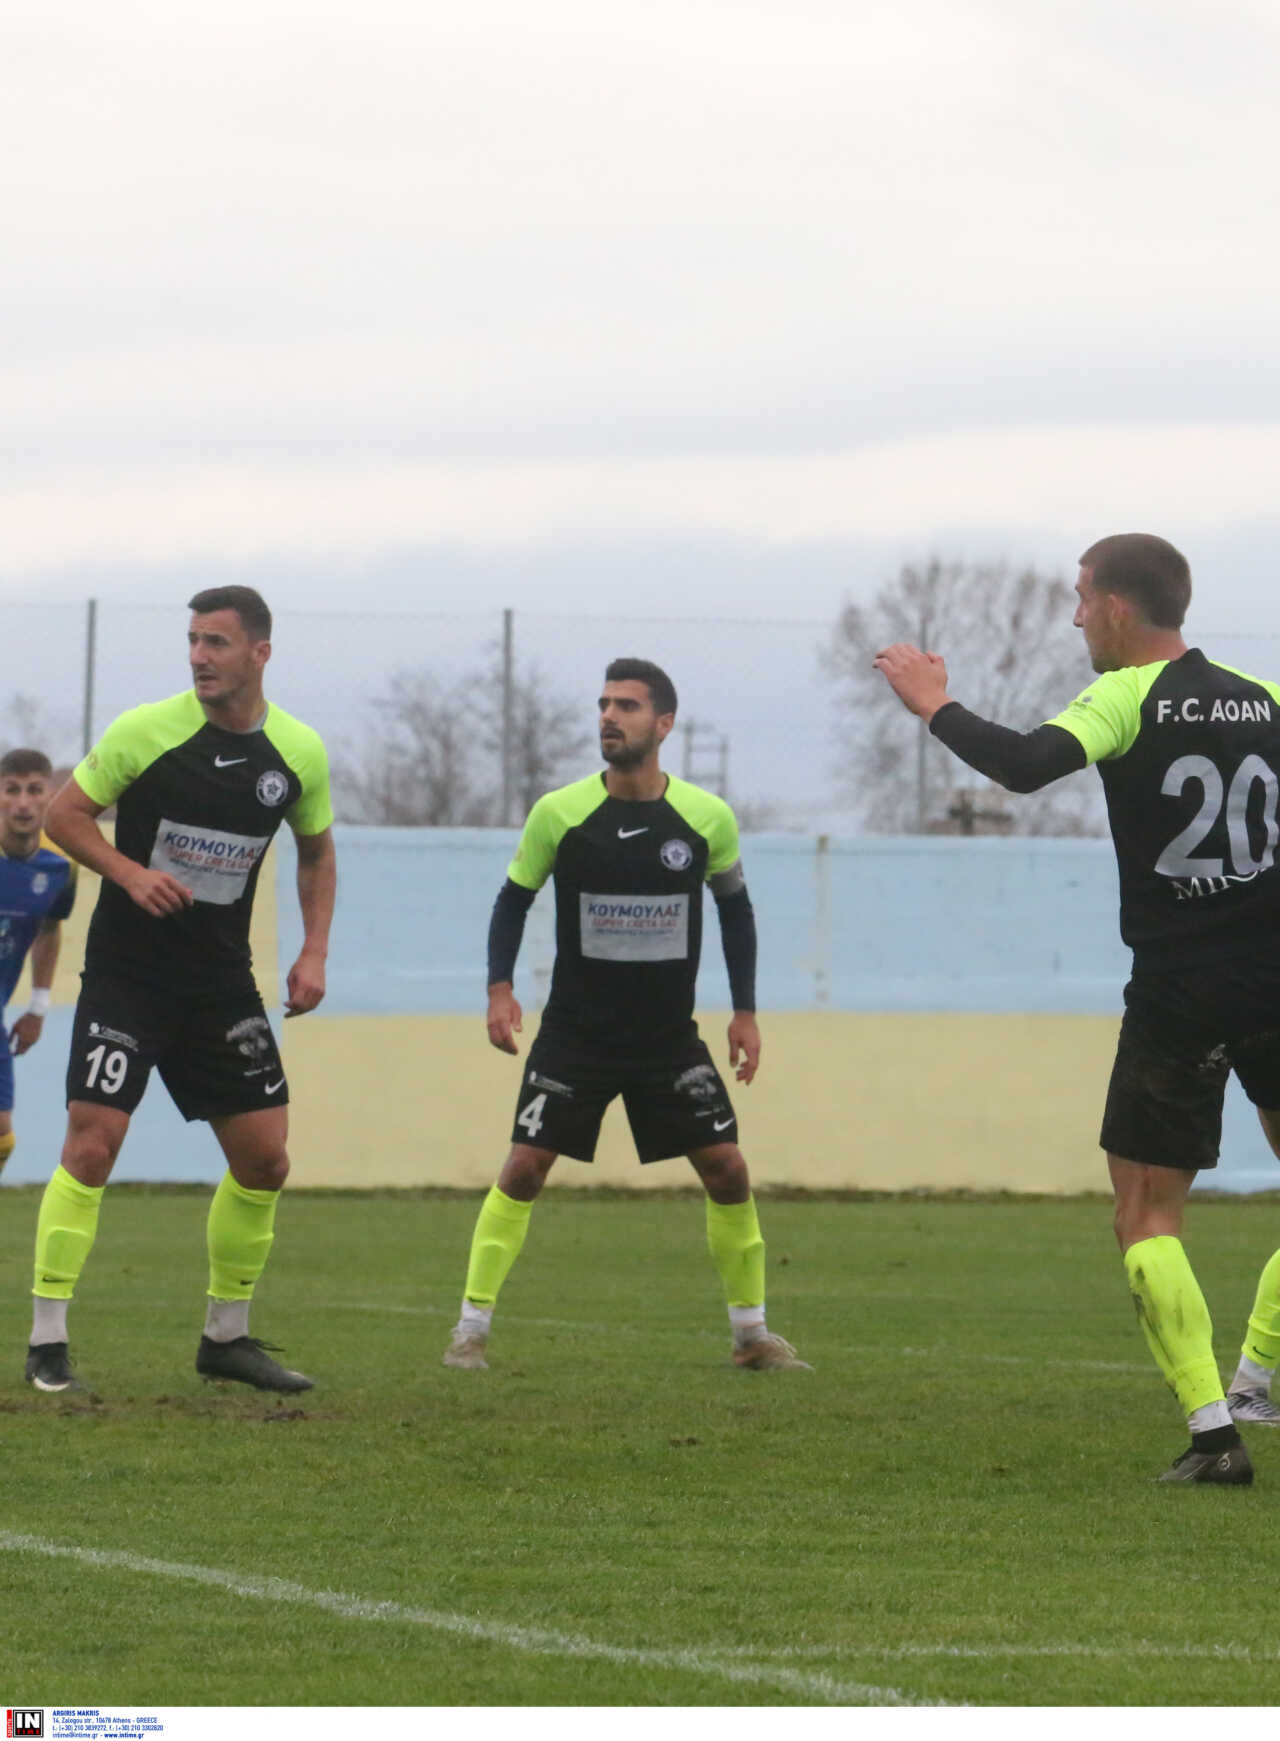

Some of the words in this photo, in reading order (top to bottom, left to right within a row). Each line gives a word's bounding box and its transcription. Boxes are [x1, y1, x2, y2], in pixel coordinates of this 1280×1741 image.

[1157, 697, 1205, 723] F.C.
[1210, 698, 1272, 722] AOAN
[1154, 753, 1280, 877] 20
[588, 903, 682, 918] ΚΟΥΜΟΥΛΑΣ
[86, 1044, 128, 1094] 19
[517, 1093, 547, 1137] 4
